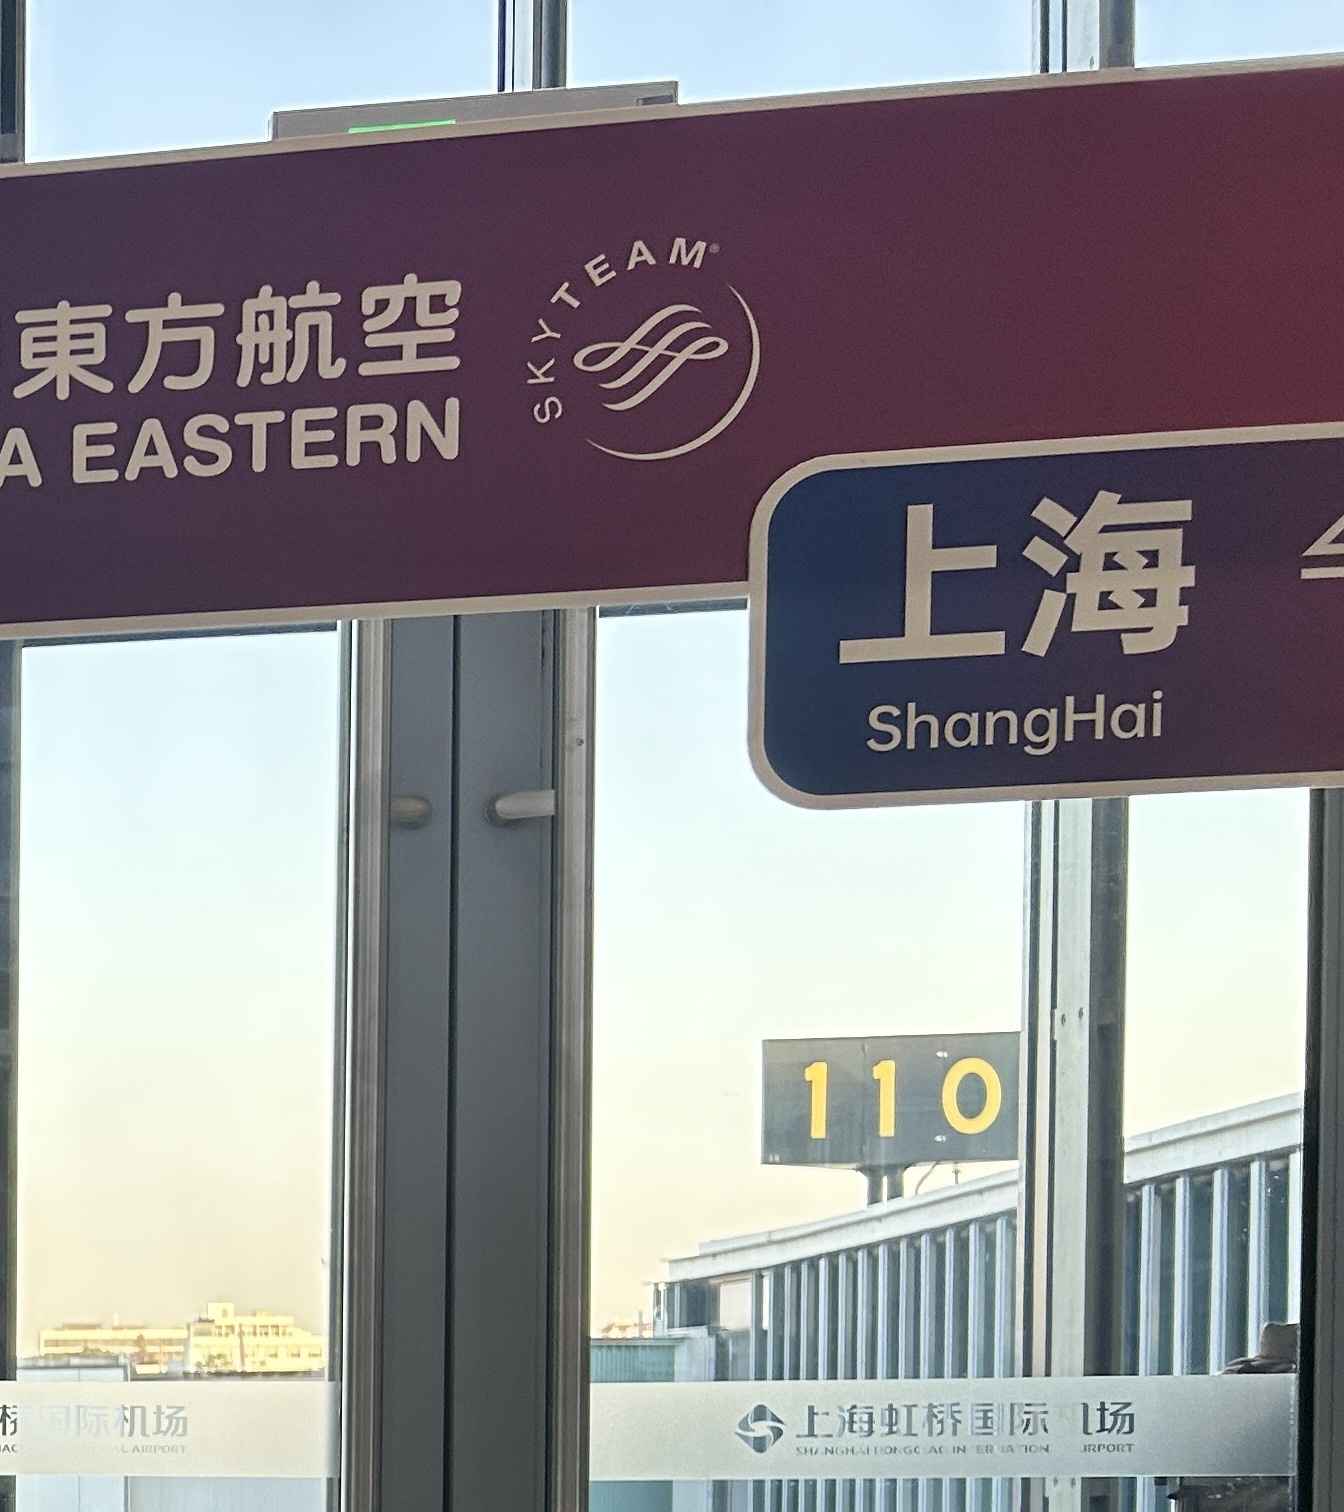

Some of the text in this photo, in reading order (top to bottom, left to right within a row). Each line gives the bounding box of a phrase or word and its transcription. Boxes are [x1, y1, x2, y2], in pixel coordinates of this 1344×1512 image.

[526, 236, 707, 424] SKYTEAM
[70, 396, 462, 486] EASTERN
[838, 489, 1197, 665] 上海
[866, 689, 1165, 757] ShangHai
[803, 1056, 1003, 1140] 110
